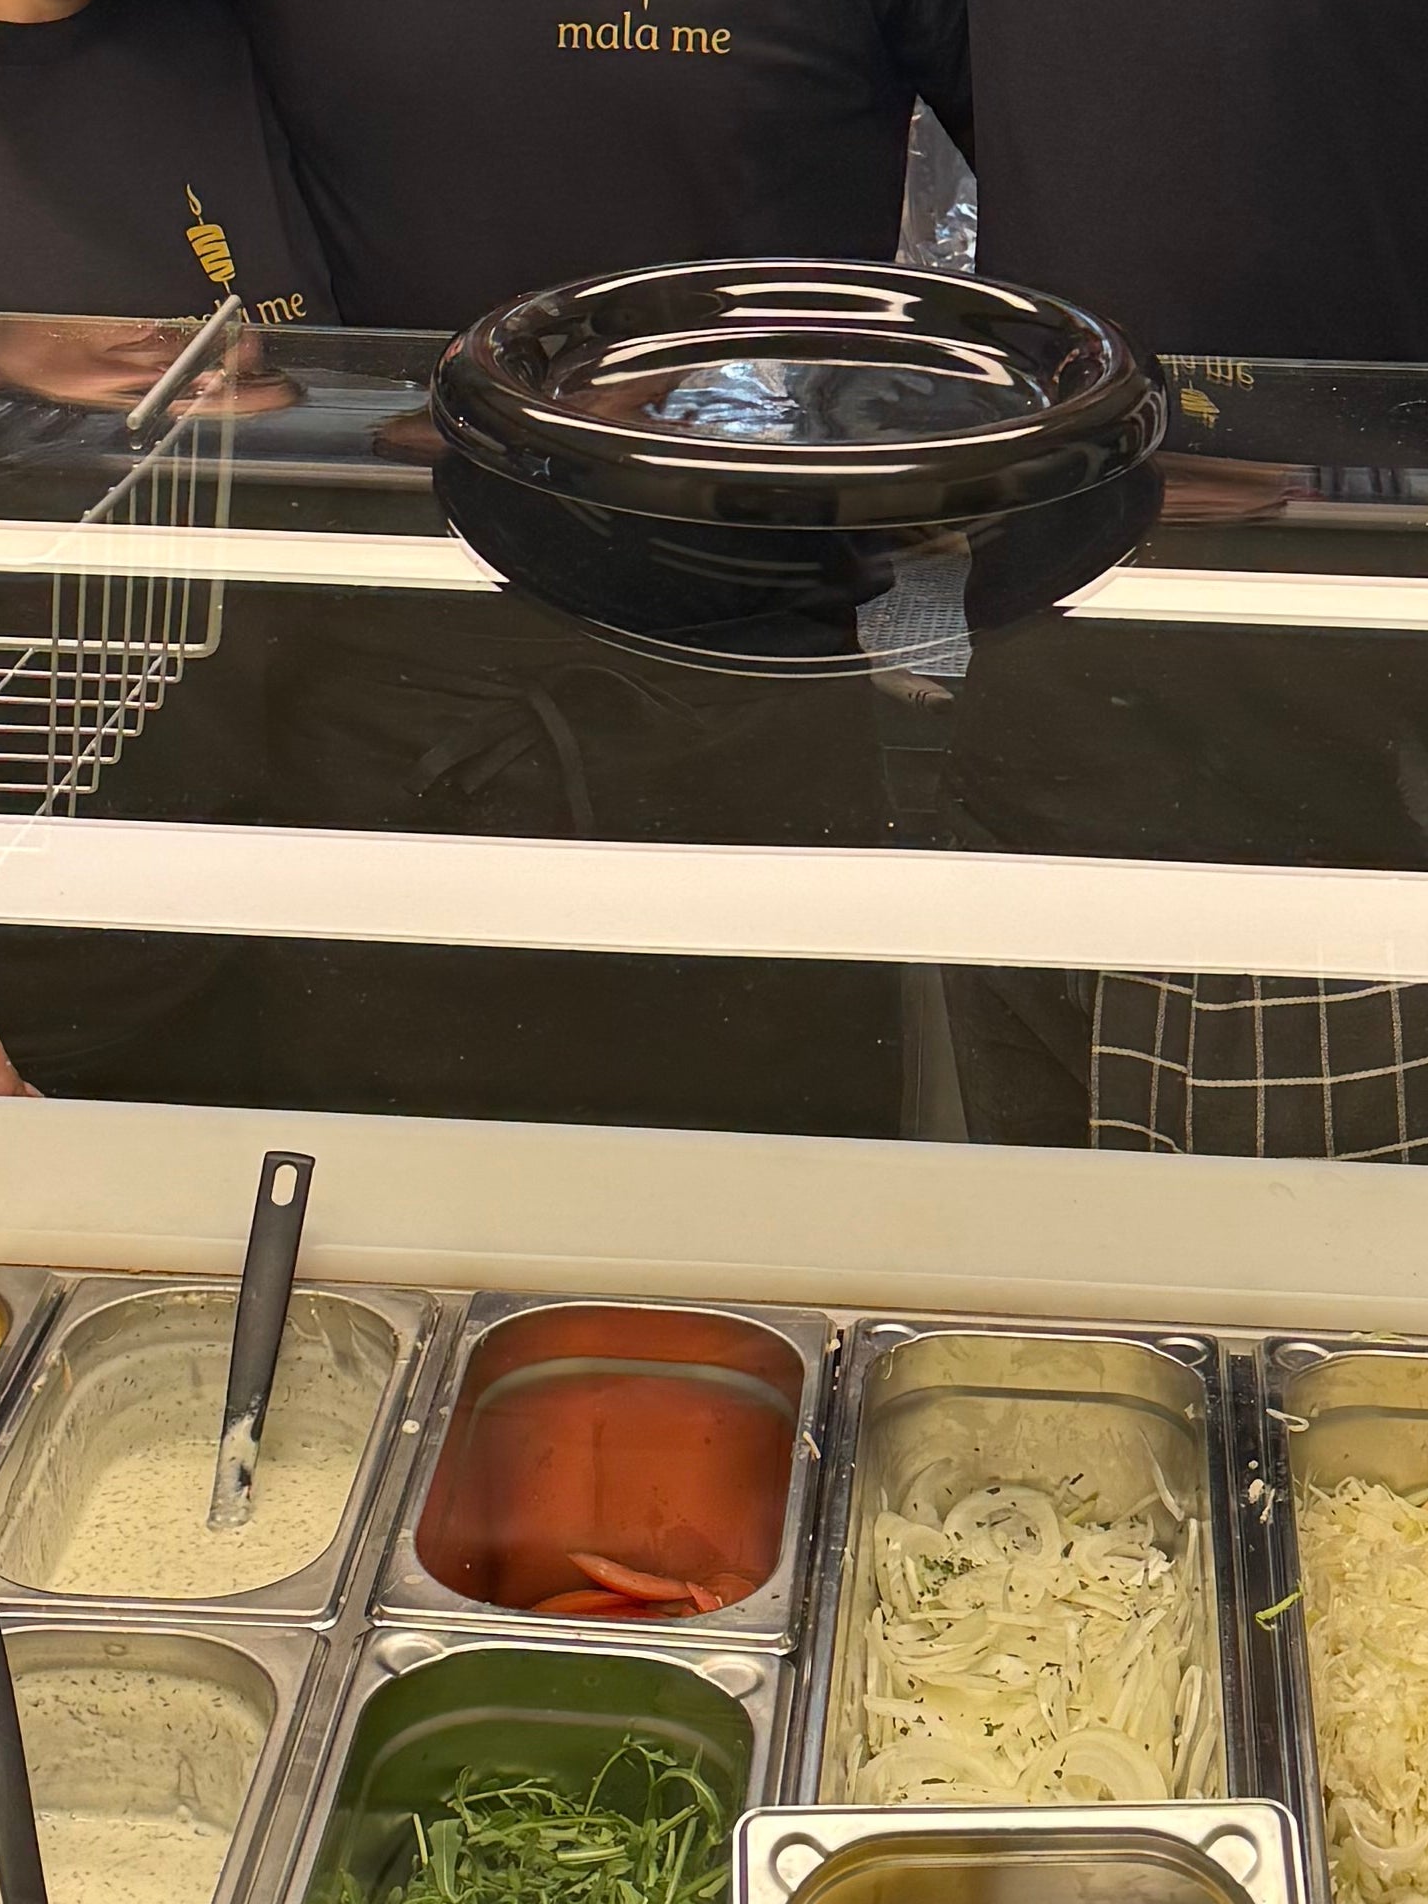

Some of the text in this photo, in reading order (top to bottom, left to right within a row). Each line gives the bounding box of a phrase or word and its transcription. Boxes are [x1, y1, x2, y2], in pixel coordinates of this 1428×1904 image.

[557, 11, 732, 54] mala me
[256, 292, 307, 325] me
